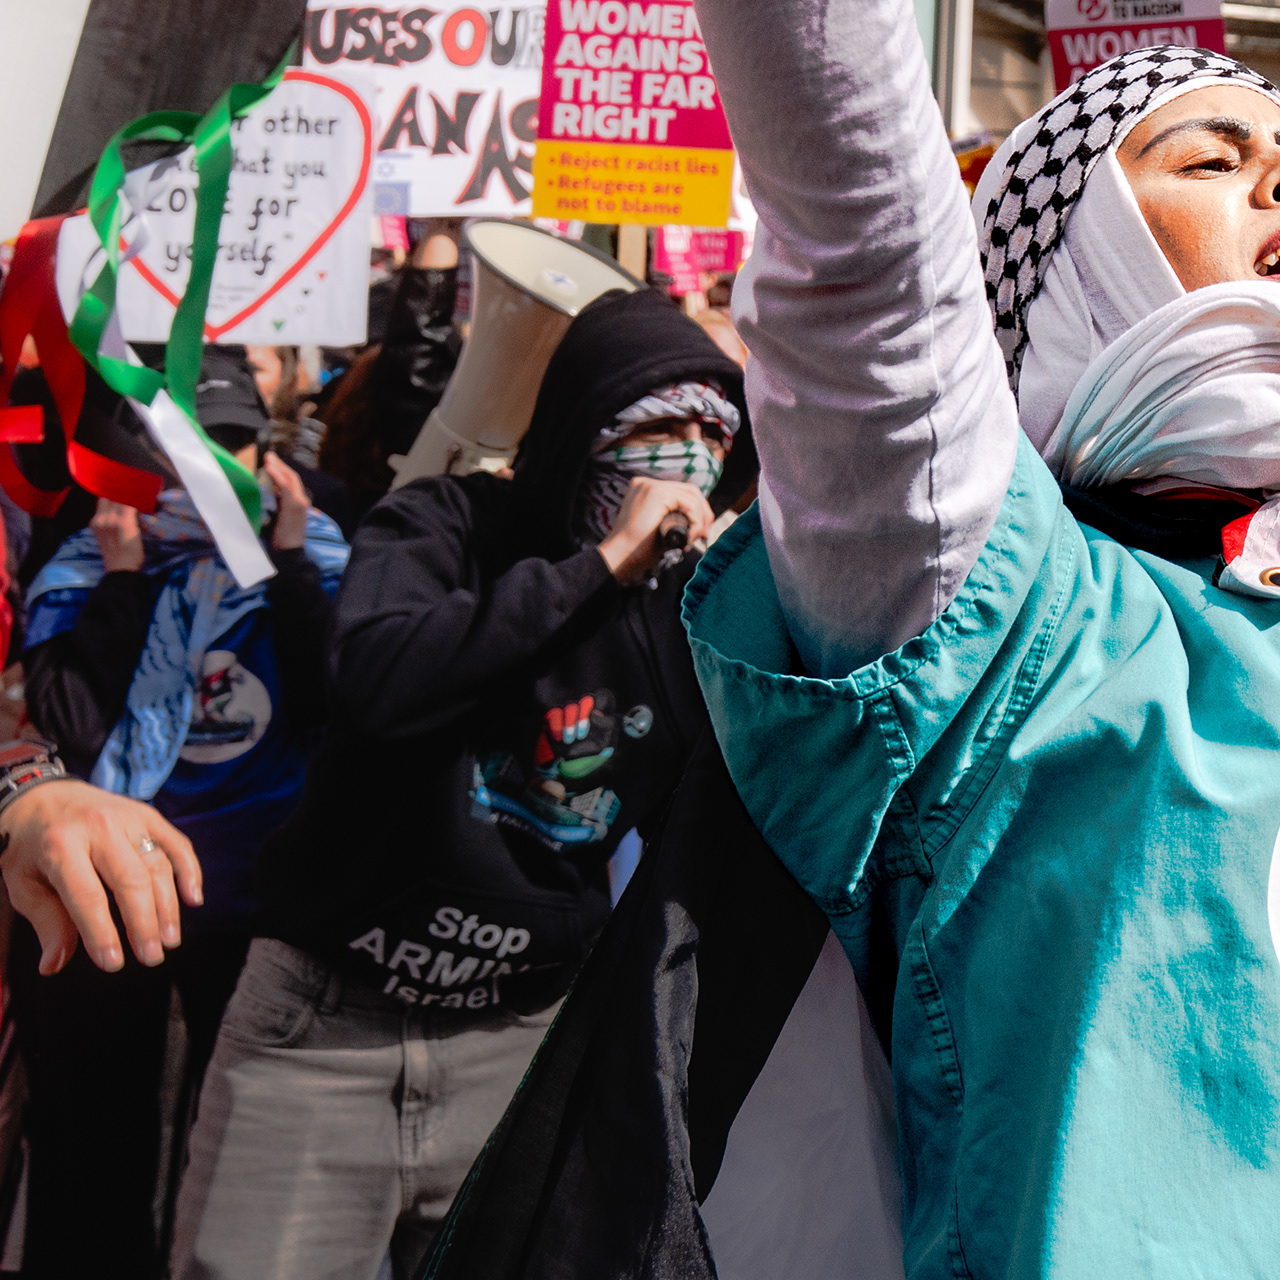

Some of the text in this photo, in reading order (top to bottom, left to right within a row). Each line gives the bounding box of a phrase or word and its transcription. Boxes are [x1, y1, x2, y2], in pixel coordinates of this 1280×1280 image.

[1133, 1, 1184, 18] RACISM
[308, 7, 438, 66] USES
[554, 32, 714, 76] AGAINS
[554, 67, 717, 110] THE FAR
[264, 107, 338, 135] other
[552, 101, 677, 143] RIGHT
[283, 160, 325, 190] you
[558, 151, 719, 175] Reject racist lies
[557, 174, 683, 196] Refugees are
[247, 197, 298, 231] for
[556, 196, 682, 215] not to blame
[428, 906, 531, 959] Stop
[383, 974, 501, 1009] Israel
